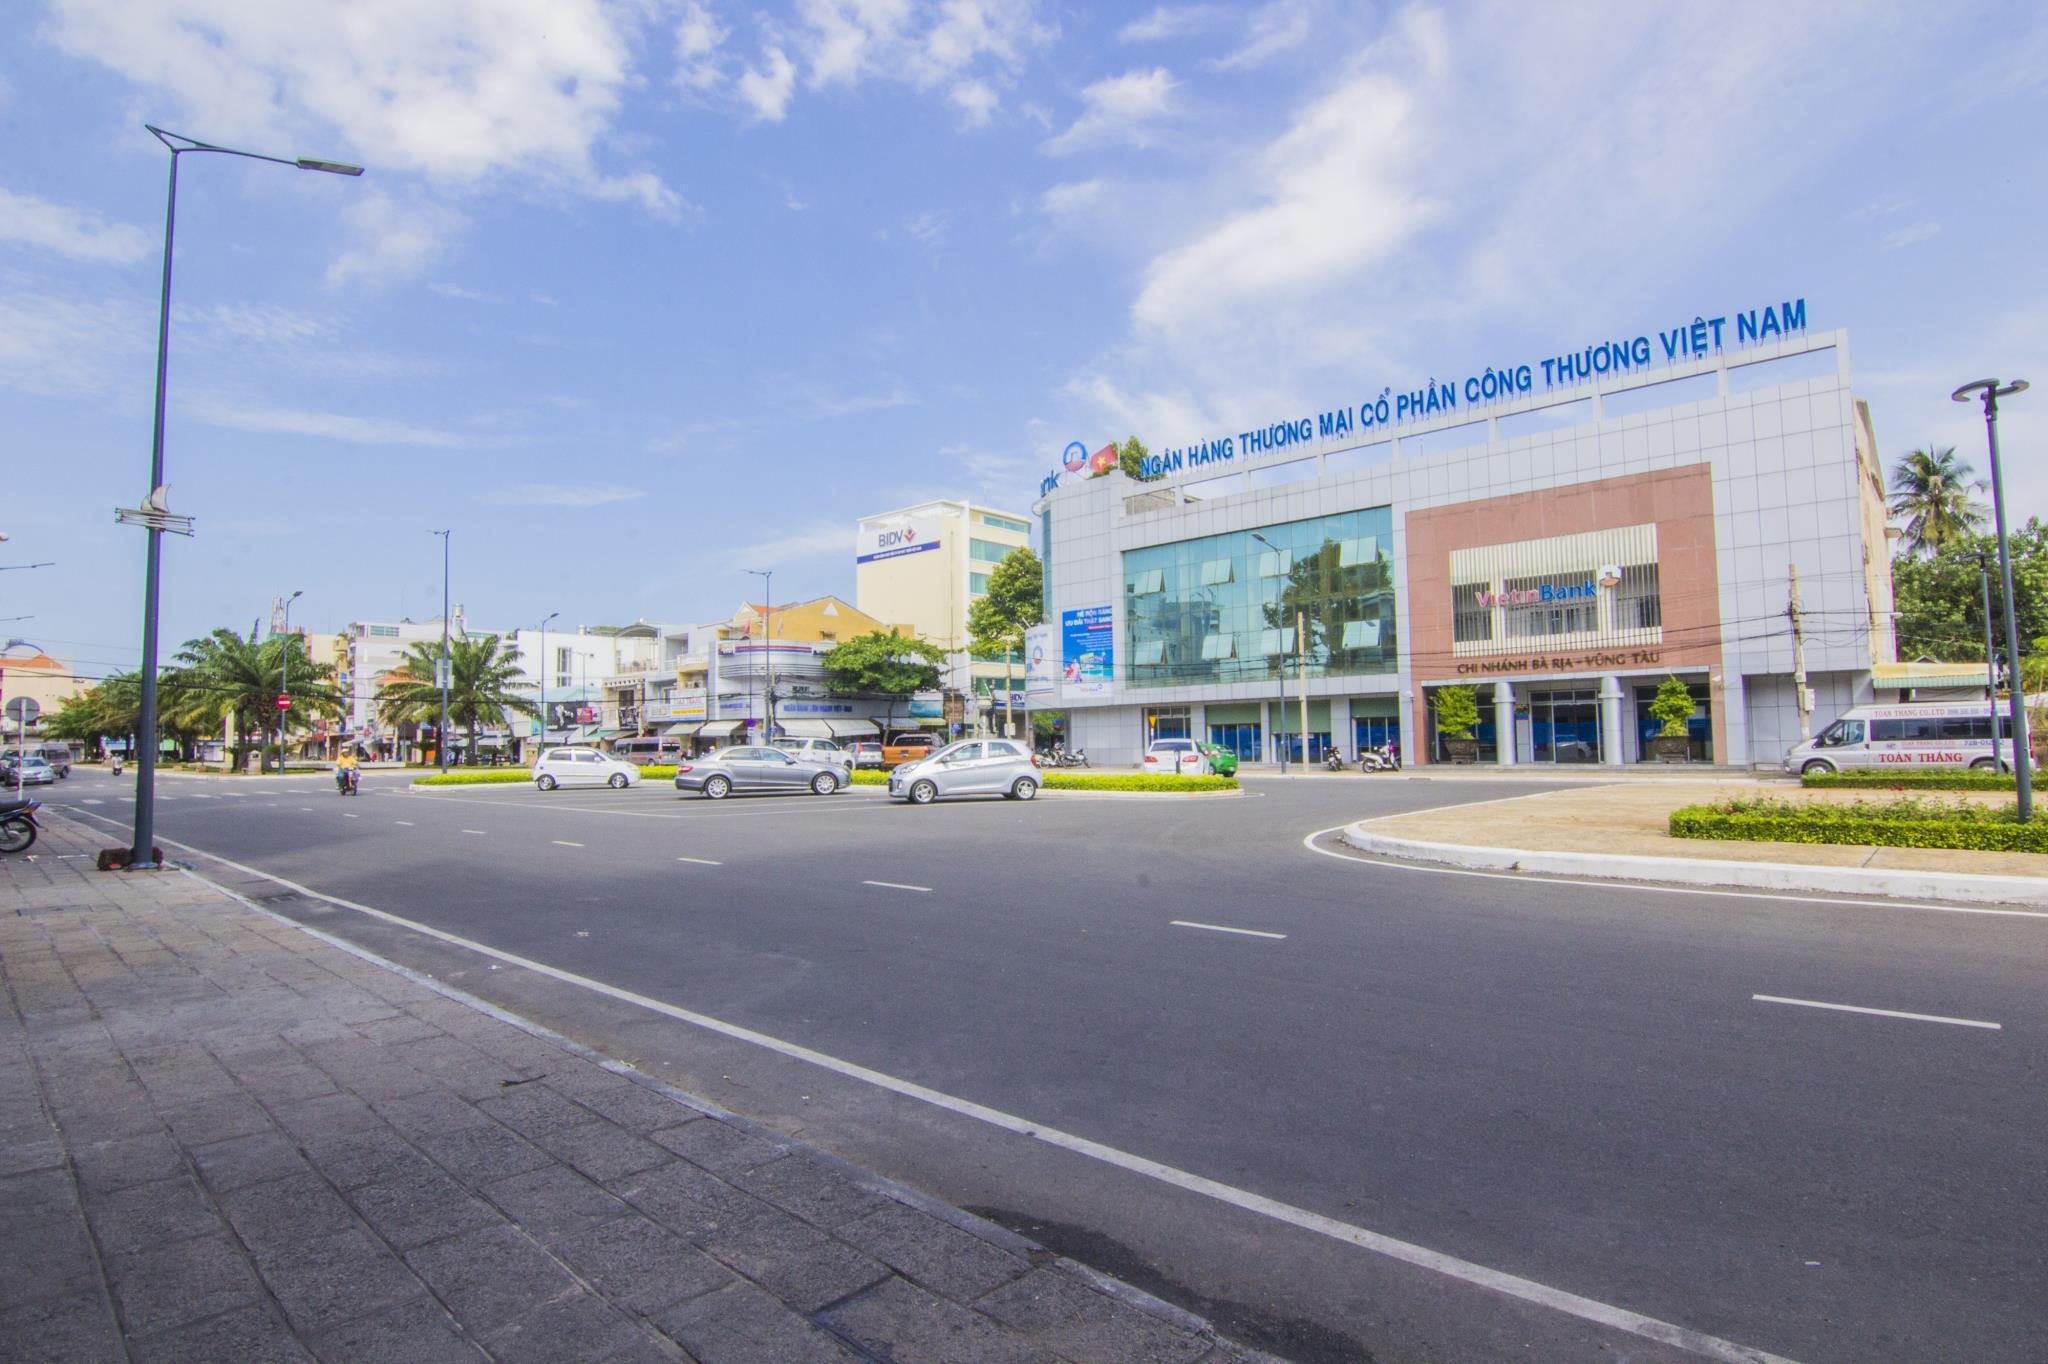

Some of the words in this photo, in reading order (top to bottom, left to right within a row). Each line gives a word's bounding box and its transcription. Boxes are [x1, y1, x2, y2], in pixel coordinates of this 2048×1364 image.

[1140, 447, 1183, 478] NGÂN
[1188, 435, 1234, 467] HÀNG
[1239, 417, 1312, 456] THƯƠNG
[1319, 406, 1354, 439] MẠI
[1360, 386, 1392, 428] CỔ
[1396, 376, 1457, 420] PHẦN
[1465, 365, 1533, 403] CÔNG
[1540, 336, 1651, 386] THƯƠNG
[1660, 316, 1727, 359] VIỆT
[1737, 298, 1807, 342] NAM
[878, 530, 904, 547] BIDV
[1474, 580, 1597, 609] VietinBank
[1457, 663, 1478, 674] CHI
[1481, 658, 1527, 673] NHÁNH
[1532, 655, 1548, 670] BÀ
[1552, 657, 1573, 671] RỊA
[1584, 652, 1626, 666] VŨNG
[1632, 649, 1660, 664] TÀU
[1879, 751, 1912, 763] TOÀN
